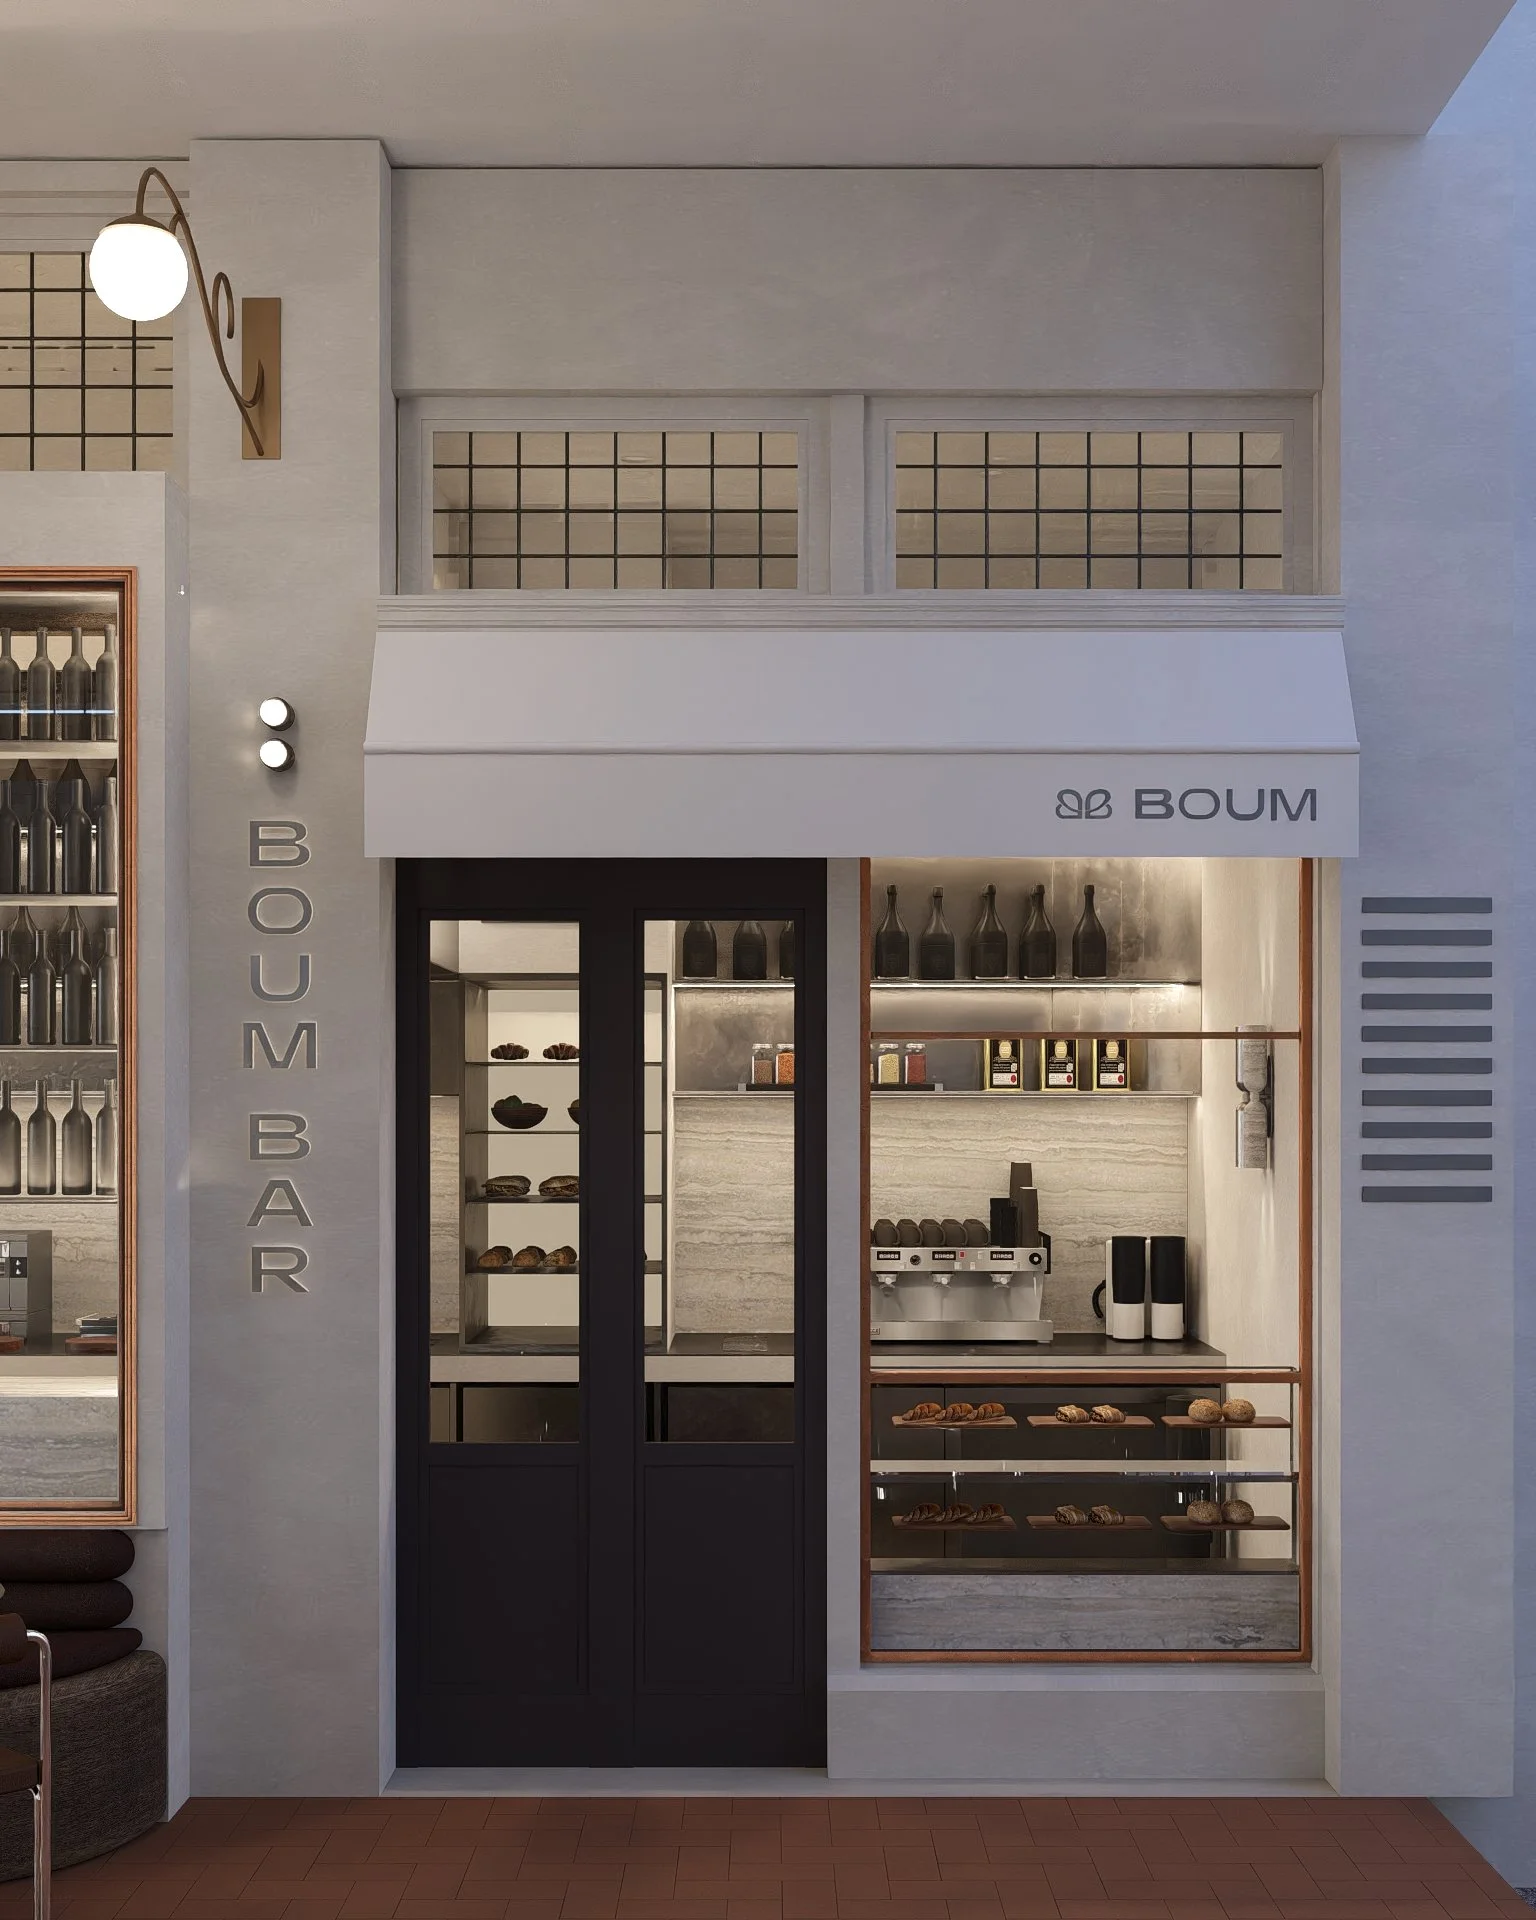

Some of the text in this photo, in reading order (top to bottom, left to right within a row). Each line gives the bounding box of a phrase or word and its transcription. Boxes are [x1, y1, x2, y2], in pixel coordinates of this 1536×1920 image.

[1134, 788, 1317, 822] BOUM
[242, 820, 317, 1293] BOUM BAR
